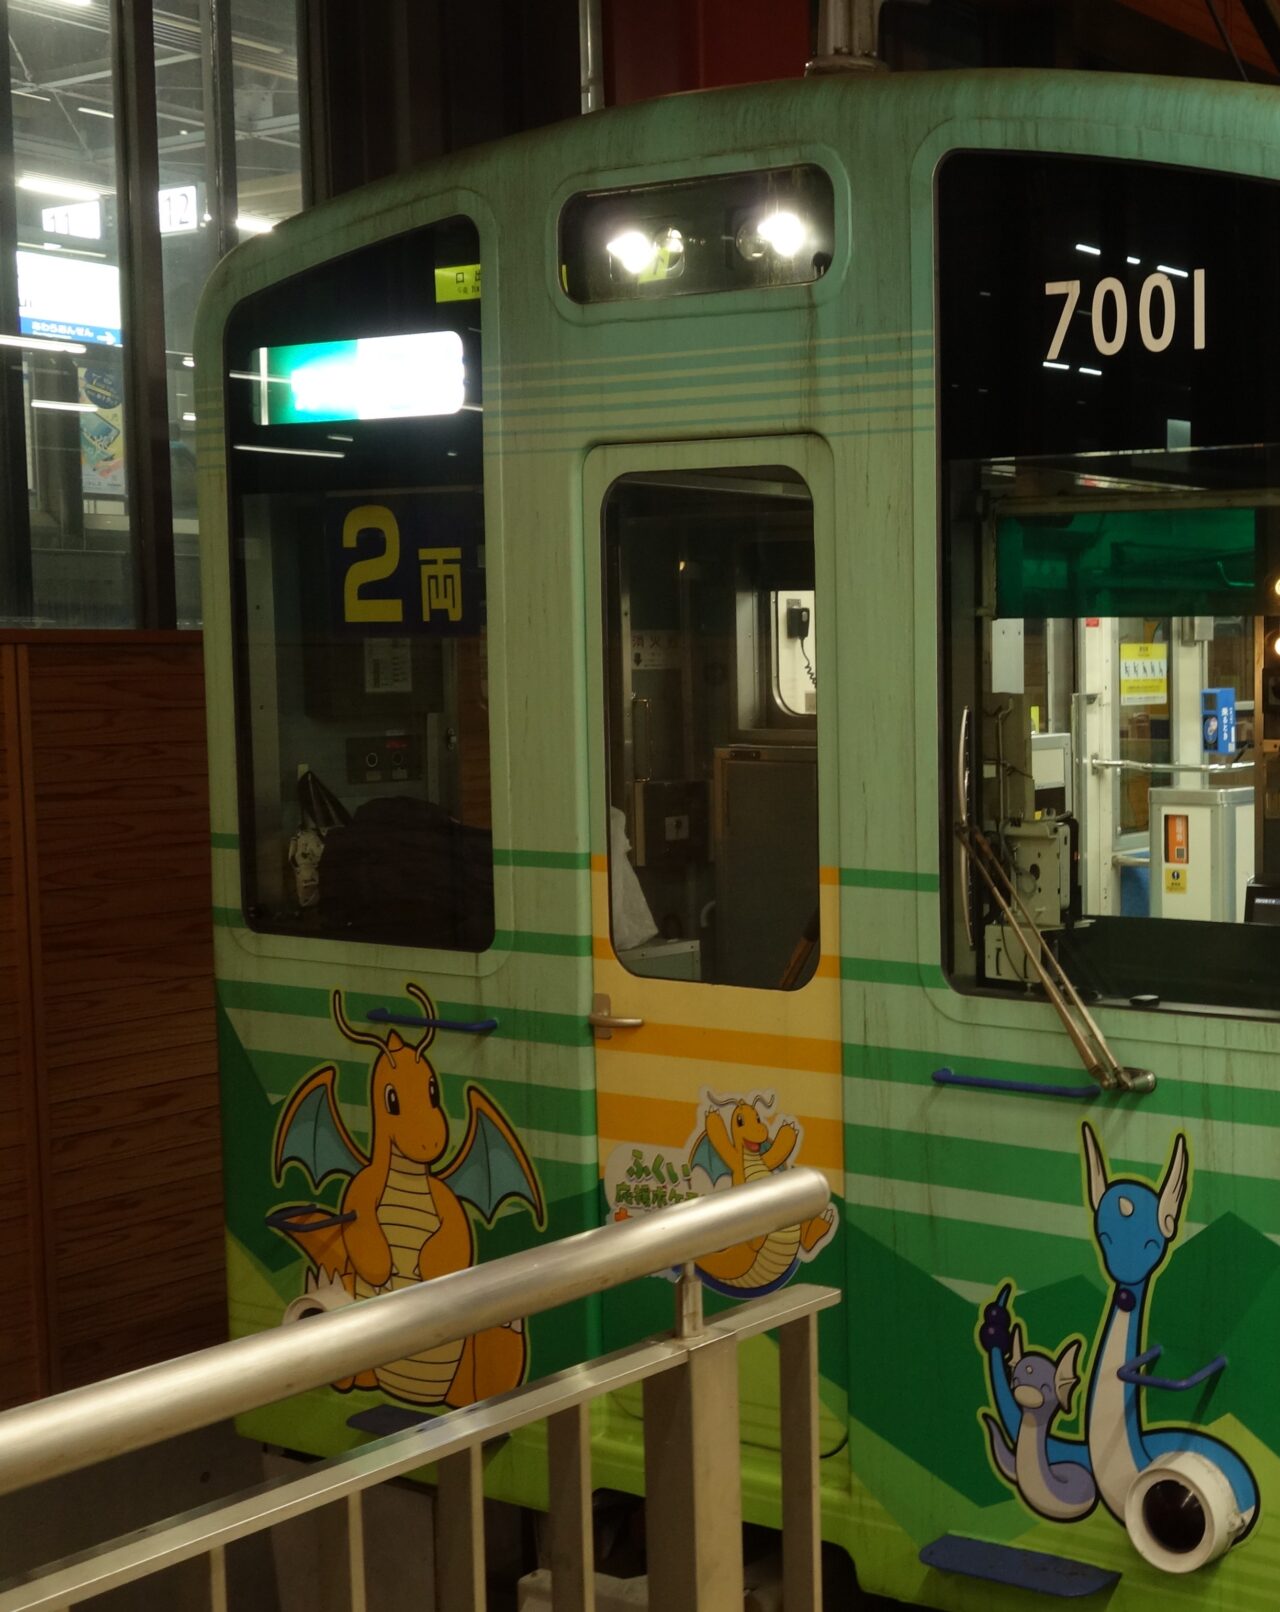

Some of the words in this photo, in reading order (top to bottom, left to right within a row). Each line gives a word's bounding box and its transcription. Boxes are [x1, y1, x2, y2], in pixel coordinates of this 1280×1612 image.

[165, 193, 189, 227] 12
[1045, 268, 1205, 360] 7001
[626, 1149, 692, 1186] ふくい
[615, 1181, 704, 1208] 応援ポケ
